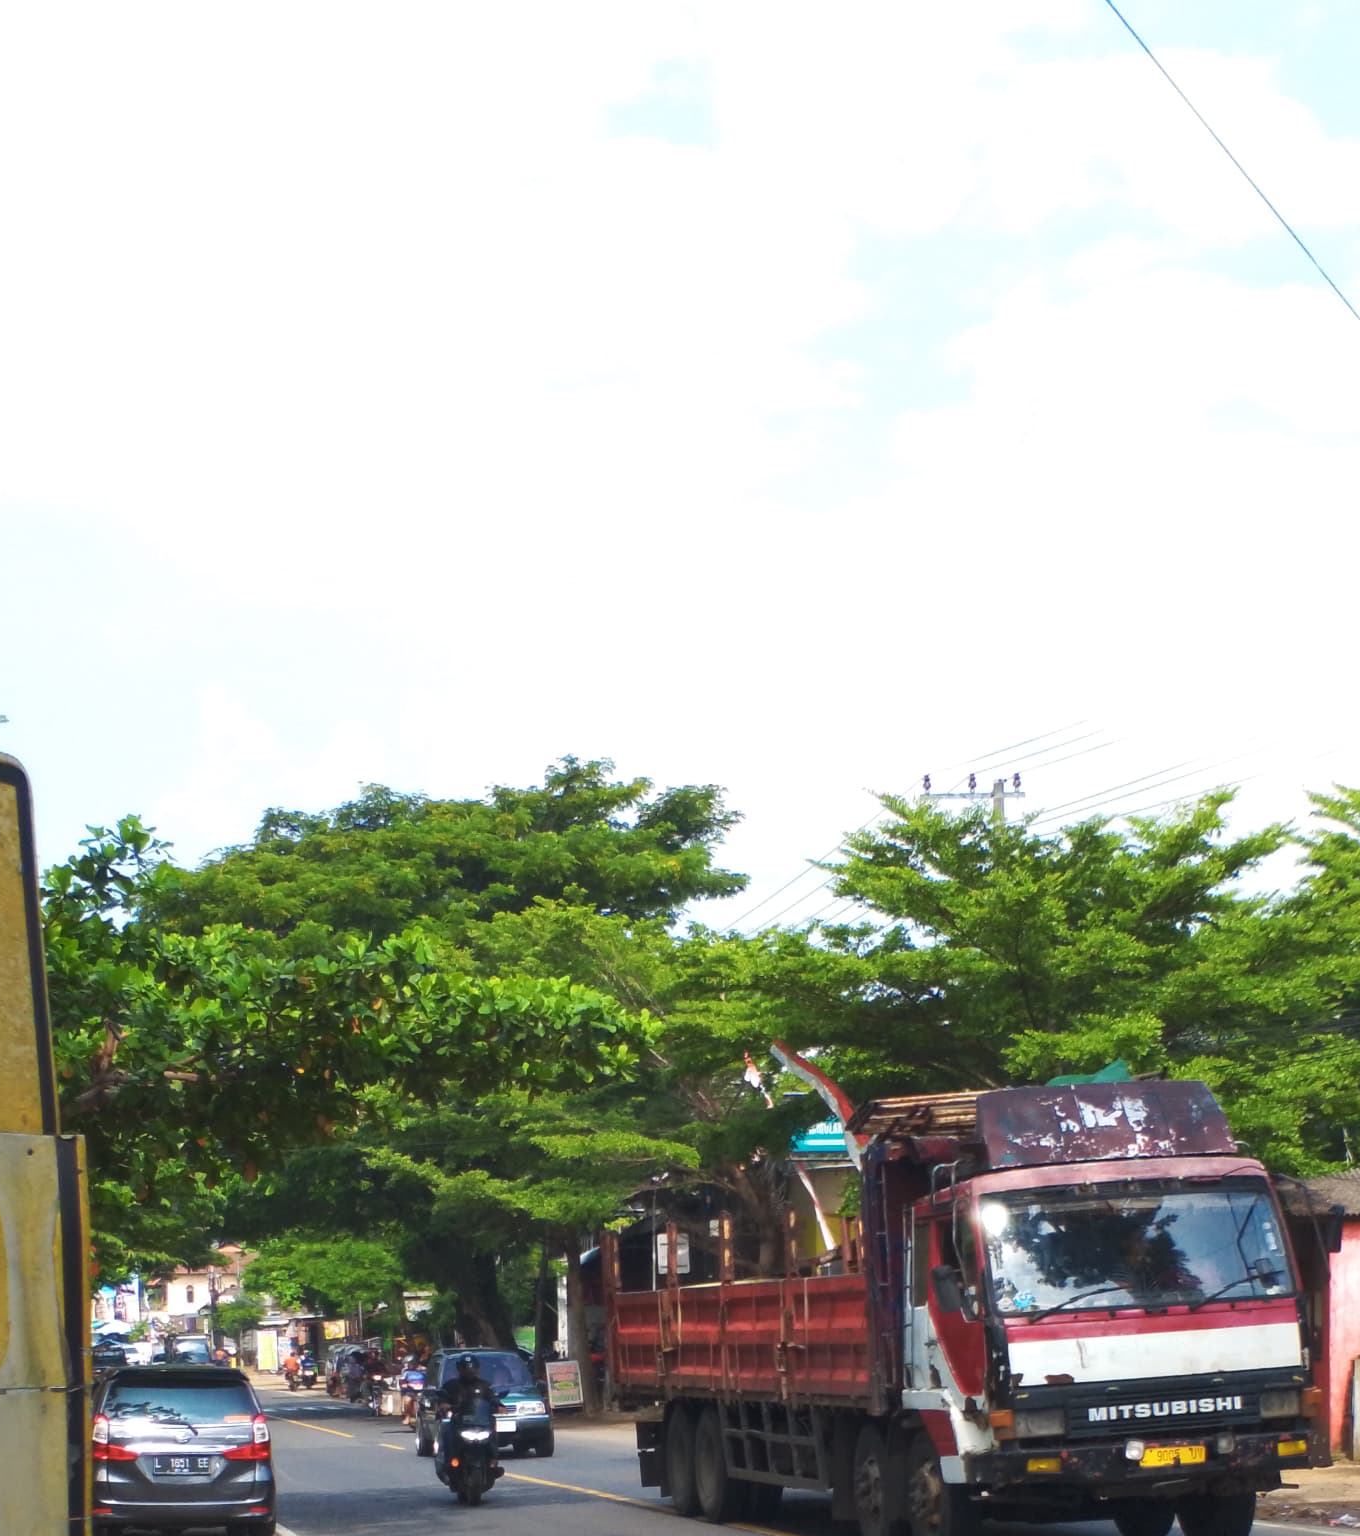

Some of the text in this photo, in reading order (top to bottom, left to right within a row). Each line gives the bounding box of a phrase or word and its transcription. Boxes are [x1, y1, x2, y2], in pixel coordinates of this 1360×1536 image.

[1087, 1395, 1243, 1422] MITSUBISHI
[155, 1458, 161, 1468] L
[198, 1457, 209, 1468] EE
